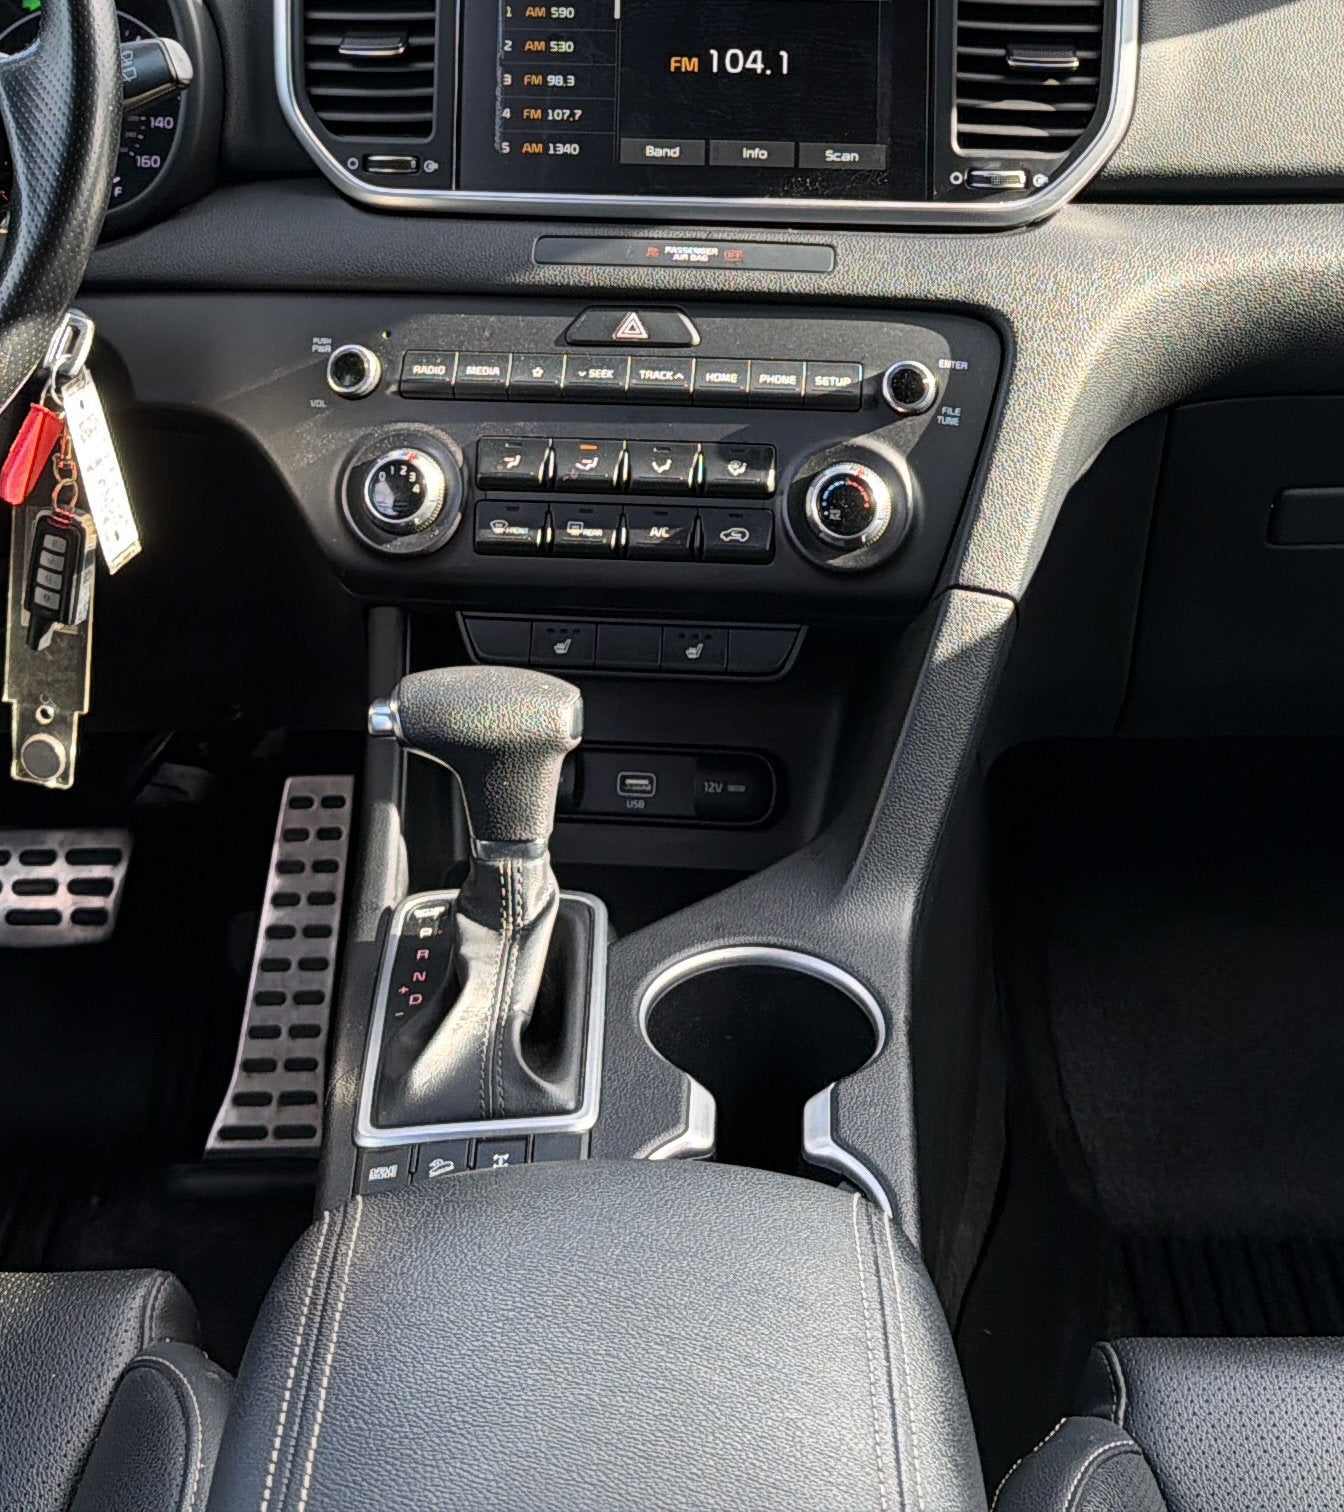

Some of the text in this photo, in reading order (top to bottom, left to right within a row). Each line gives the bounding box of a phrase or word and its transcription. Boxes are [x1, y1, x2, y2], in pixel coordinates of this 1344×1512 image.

[505, 6, 575, 19] 1 AM 590
[503, 40, 575, 53] 2 AM 530
[669, 48, 790, 76] FM 104.1
[502, 73, 575, 87] 3 FM 98.3
[502, 108, 583, 122] 4 FM 107.7
[149, 116, 174, 129] 140
[501, 142, 580, 156] 5 AM 1340
[645, 145, 681, 159] Band
[742, 147, 769, 160] Info
[135, 155, 161, 168] 160
[824, 150, 860, 163] Scan
[664, 245, 719, 256] PASSENGER
[672, 253, 689, 261] AIR
[312, 337, 333, 345] PUSH
[412, 364, 446, 376] RADIO
[938, 358, 969, 371] ENTER
[465, 365, 500, 377] MEDIA
[588, 368, 615, 380] SEEK
[639, 369, 674, 381] TRACK
[705, 372, 738, 384] HOME
[759, 374, 797, 386] PHONE
[814, 375, 852, 388] SETUP
[309, 399, 328, 408] VOL
[941, 406, 962, 417] FILE
[936, 415, 960, 427] TUNE
[389, 465, 395, 476] 1
[399, 464, 408, 476] 2
[408, 471, 417, 483] 3
[412, 483, 421, 495] 4
[649, 526, 670, 537] A/C
[704, 781, 724, 793] 12V
[626, 799, 645, 809] USB
[419, 927, 433, 940] P
[416, 948, 430, 961] R
[412, 970, 427, 982] N
[408, 993, 423, 1006] D
